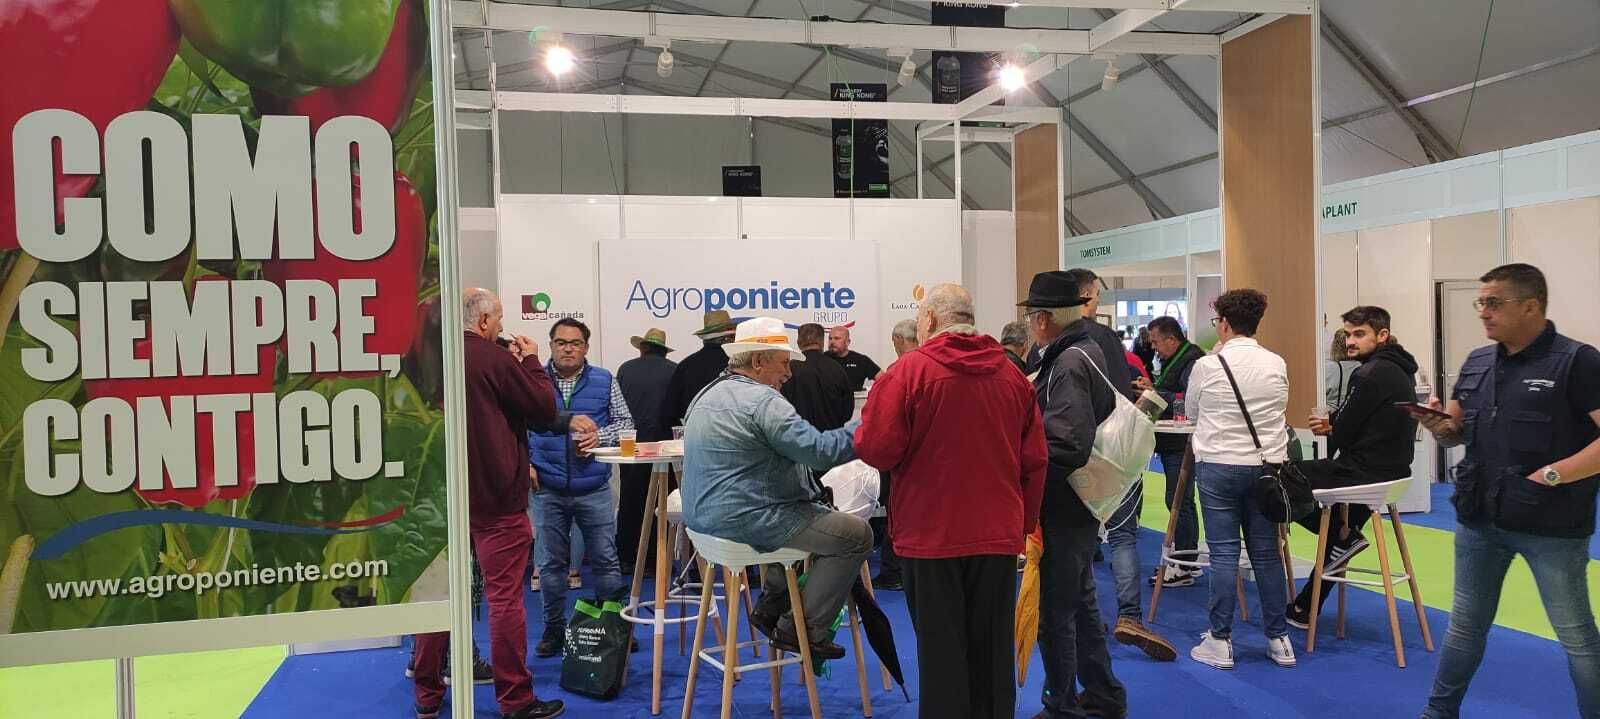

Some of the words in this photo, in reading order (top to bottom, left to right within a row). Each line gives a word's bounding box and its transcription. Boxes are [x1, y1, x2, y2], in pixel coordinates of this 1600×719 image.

[12, 108, 397, 262] COMO
[19, 278, 401, 381] SIEMPRE,
[626, 280, 856, 318] Agroponiente
[813, 311, 849, 323] GRUPO
[22, 388, 405, 496] CONTIGO.
[46, 558, 389, 600] www.agroponiente.com
